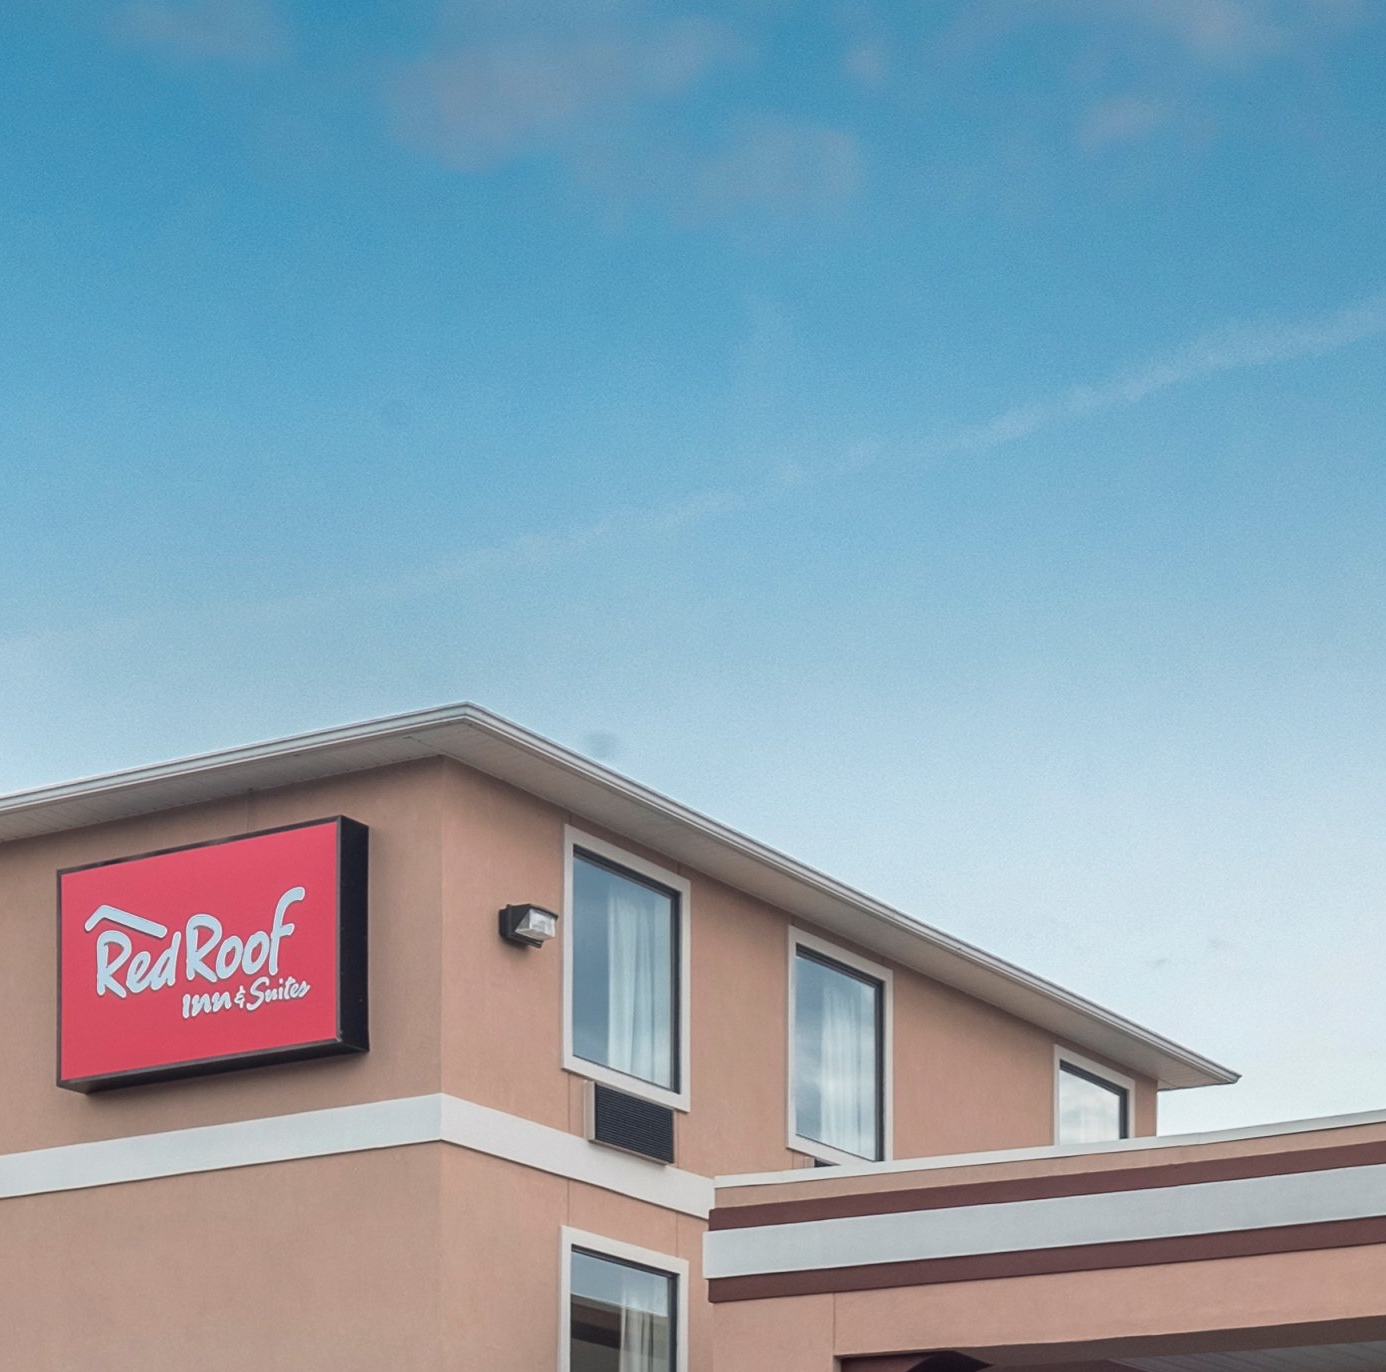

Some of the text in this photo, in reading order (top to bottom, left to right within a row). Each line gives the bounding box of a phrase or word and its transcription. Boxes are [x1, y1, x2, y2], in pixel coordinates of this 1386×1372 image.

[96, 887, 305, 998] Red Roof
[182, 976, 311, 1019] Inn & Suites
